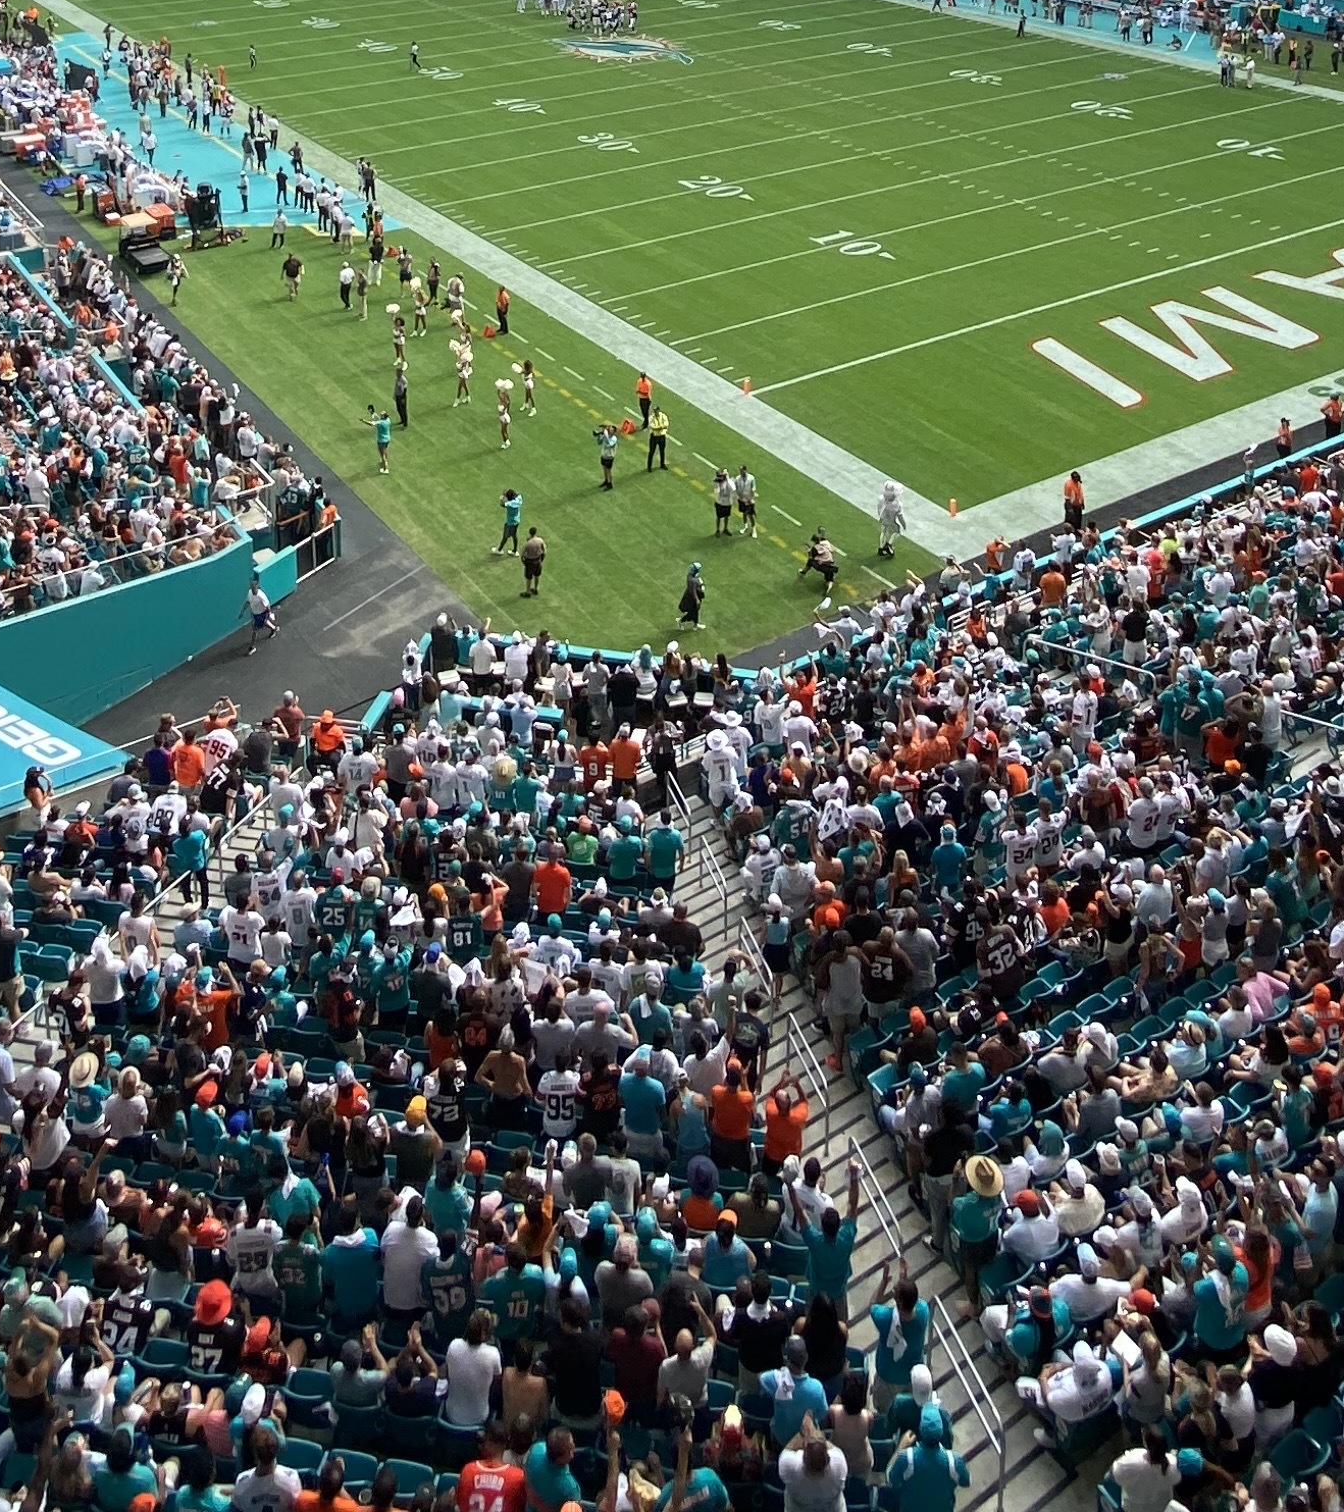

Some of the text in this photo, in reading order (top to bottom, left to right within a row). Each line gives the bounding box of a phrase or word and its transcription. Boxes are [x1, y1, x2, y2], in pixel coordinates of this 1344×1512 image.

[948, 69, 1003, 84] 30
[491, 98, 541, 112] 40
[1070, 100, 1134, 117] 20
[577, 132, 633, 151] 30
[1216, 138, 1283, 157] 10
[677, 175, 744, 198] 20
[808, 229, 882, 255] 10
[209, 740, 228, 758] 95
[349, 769, 362, 781] 14
[589, 761, 598, 776] 9
[718, 765, 726, 782] 1
[207, 769, 227, 789] 77
[1013, 851, 1033, 864] 24
[323, 908, 345, 926] 25
[359, 916, 373, 931] 14
[453, 931, 472, 947] 81
[988, 944, 1017, 974] 32
[871, 964, 893, 980] 24
[547, 1094, 574, 1120] 95
[508, 1300, 529, 1318] 10
[103, 1320, 137, 1354] 24
[198, 1333, 214, 1345] HUNT
[191, 1346, 222, 1373] 27
